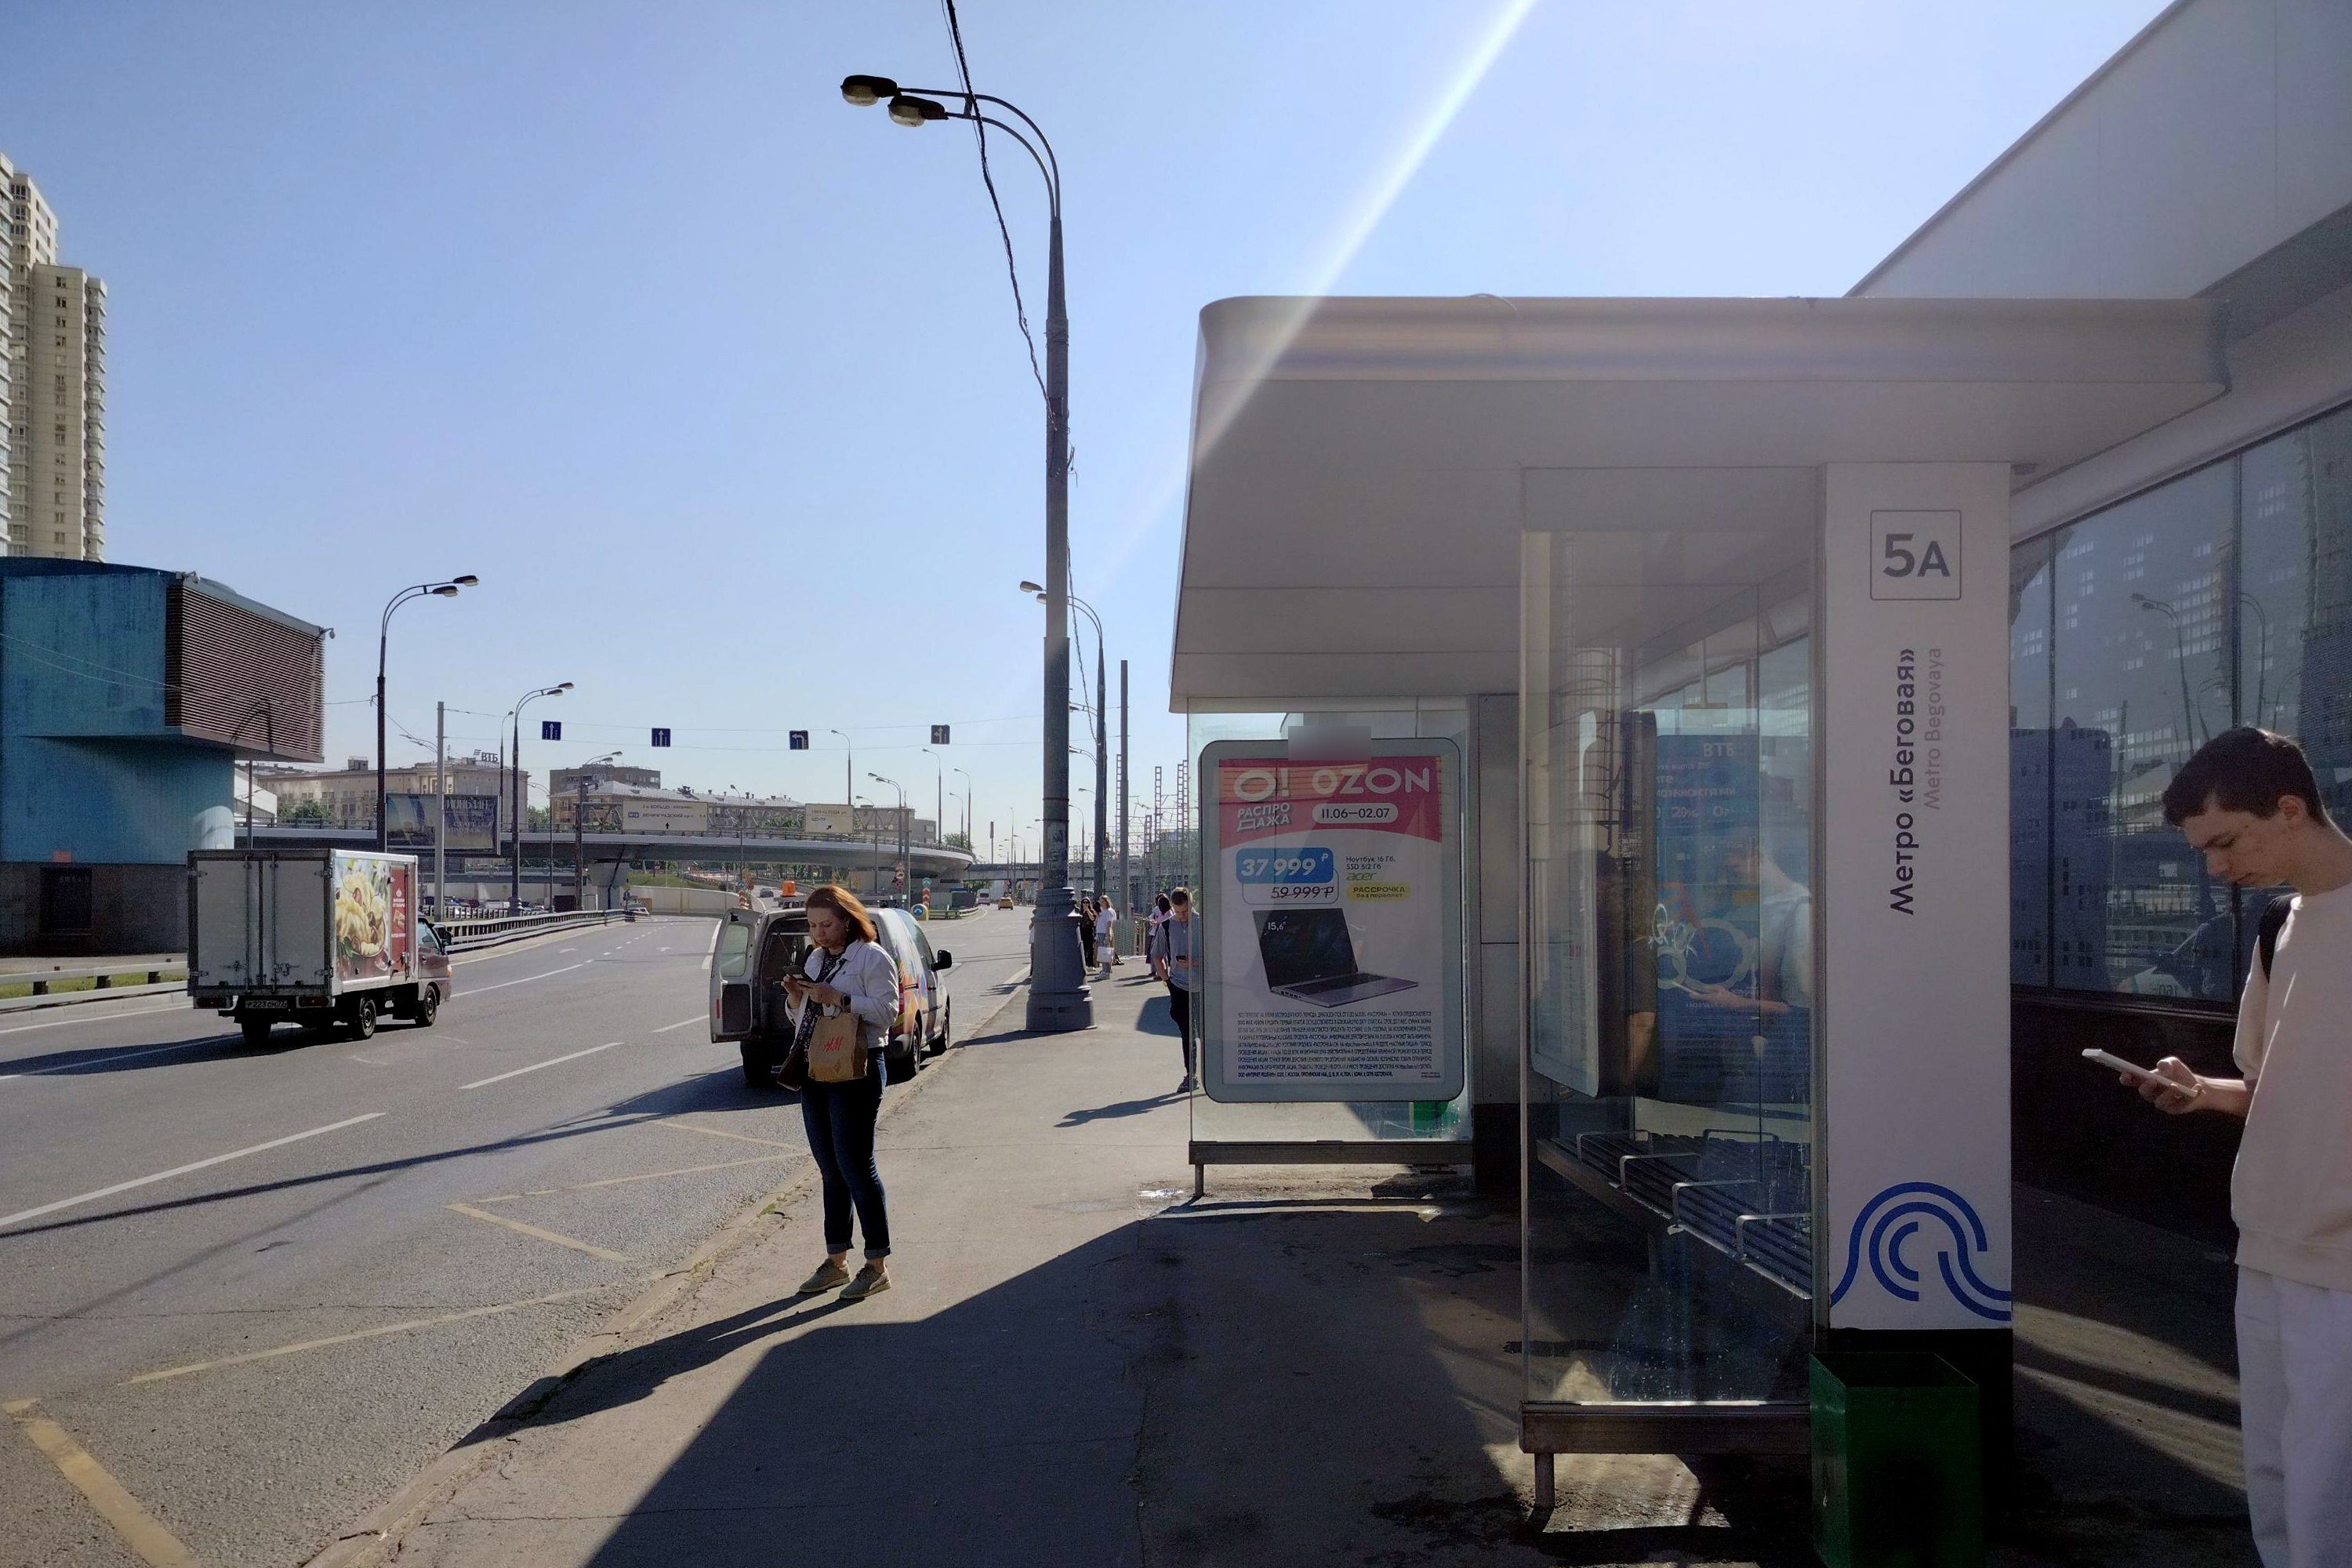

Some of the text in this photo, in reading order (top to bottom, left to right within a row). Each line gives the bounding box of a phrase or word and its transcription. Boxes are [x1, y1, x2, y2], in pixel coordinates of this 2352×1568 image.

[1883, 533, 1951, 578] 5А
[1923, 648, 1945, 811] Metro Begovaya
[481, 752, 499, 763] ВТБ
[1703, 742, 1735, 758] ВТБ
[1312, 768, 1430, 795] OZON
[1889, 648, 1920, 916] Метро «Беговая»
[1237, 802, 1290, 818] РАСПРО
[1236, 815, 1290, 832] ДАЖА
[1241, 858, 1269, 877] 37
[1273, 858, 1316, 877] 999
[1345, 873, 1377, 881] acer
